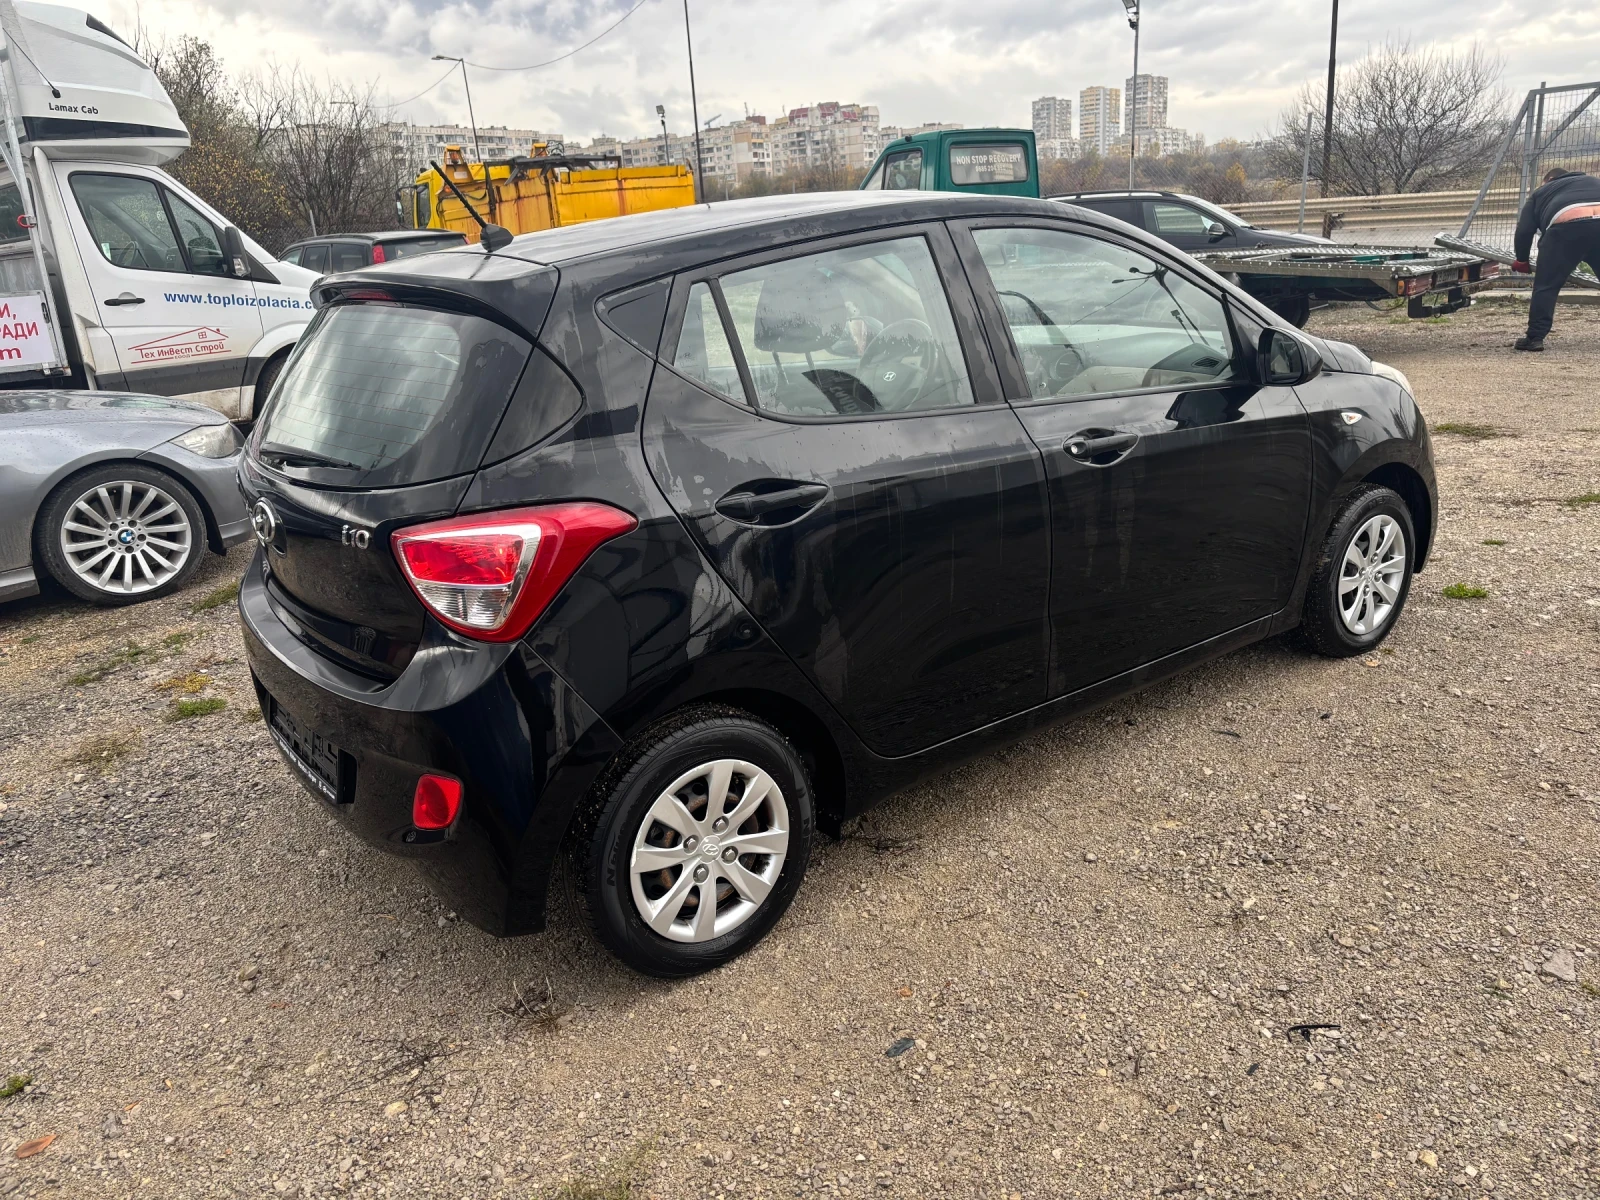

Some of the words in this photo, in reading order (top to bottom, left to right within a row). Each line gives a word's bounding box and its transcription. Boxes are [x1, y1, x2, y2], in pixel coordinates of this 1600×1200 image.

[48, 102, 79, 113] Lamax
[81, 105, 99, 115] Cab
[956, 155, 971, 165] NON
[971, 155, 987, 165] STOP
[988, 153, 1021, 164] RECOVERY
[0, 322, 39, 340] АДИ
[341, 524, 370, 549] i10
